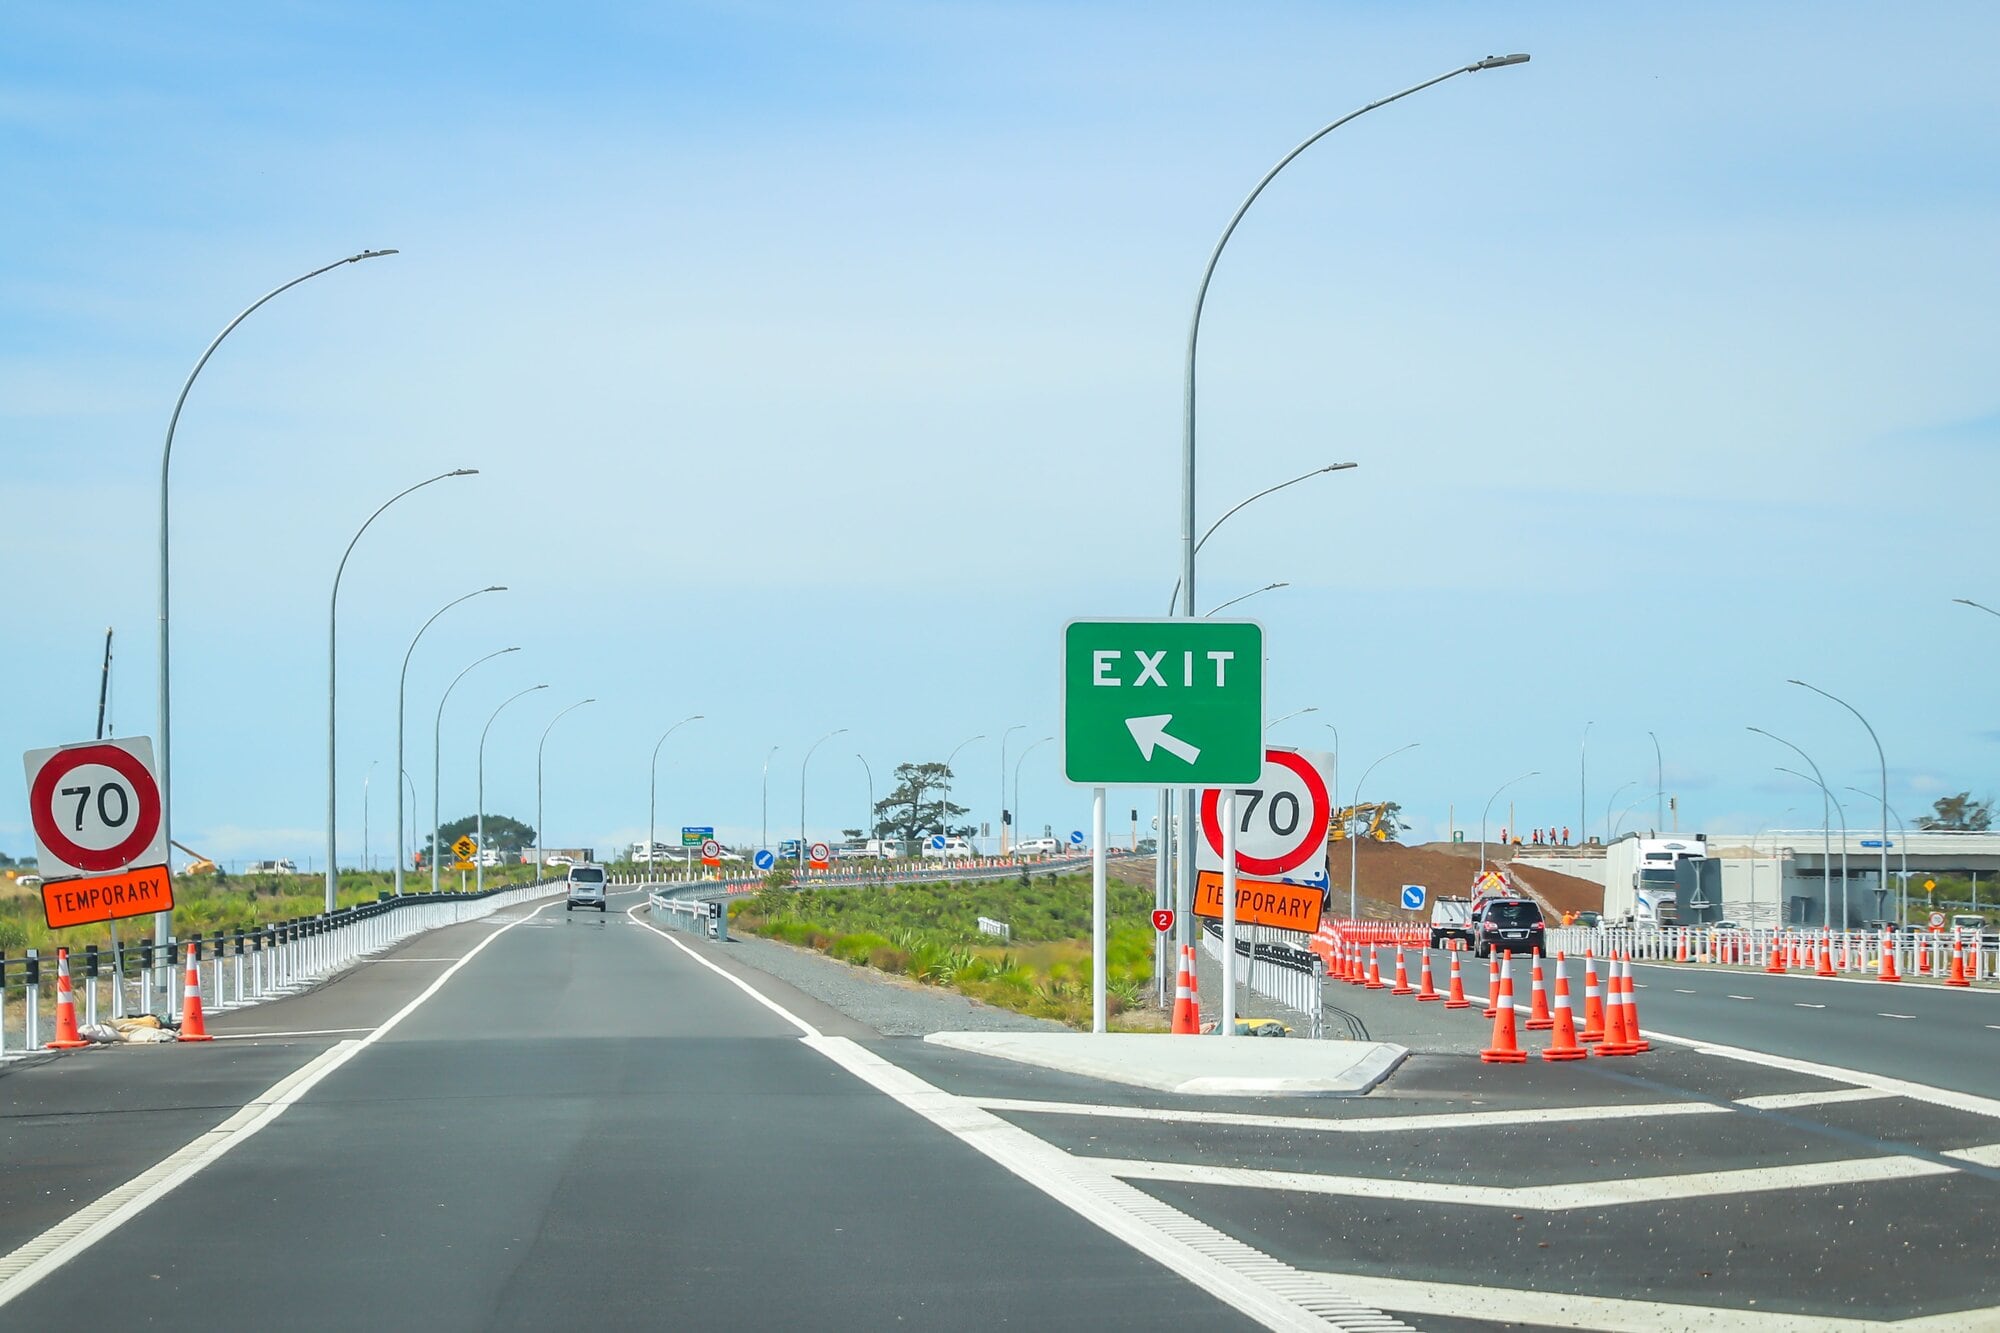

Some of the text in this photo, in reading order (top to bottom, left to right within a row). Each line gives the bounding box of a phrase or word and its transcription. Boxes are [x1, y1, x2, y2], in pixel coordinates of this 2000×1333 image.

[1093, 650, 1234, 687] EXIT
[61, 782, 129, 831] 70
[1235, 789, 1300, 836] 70
[54, 879, 160, 913] TEMPORARY
[1159, 914, 1167, 925] 2
